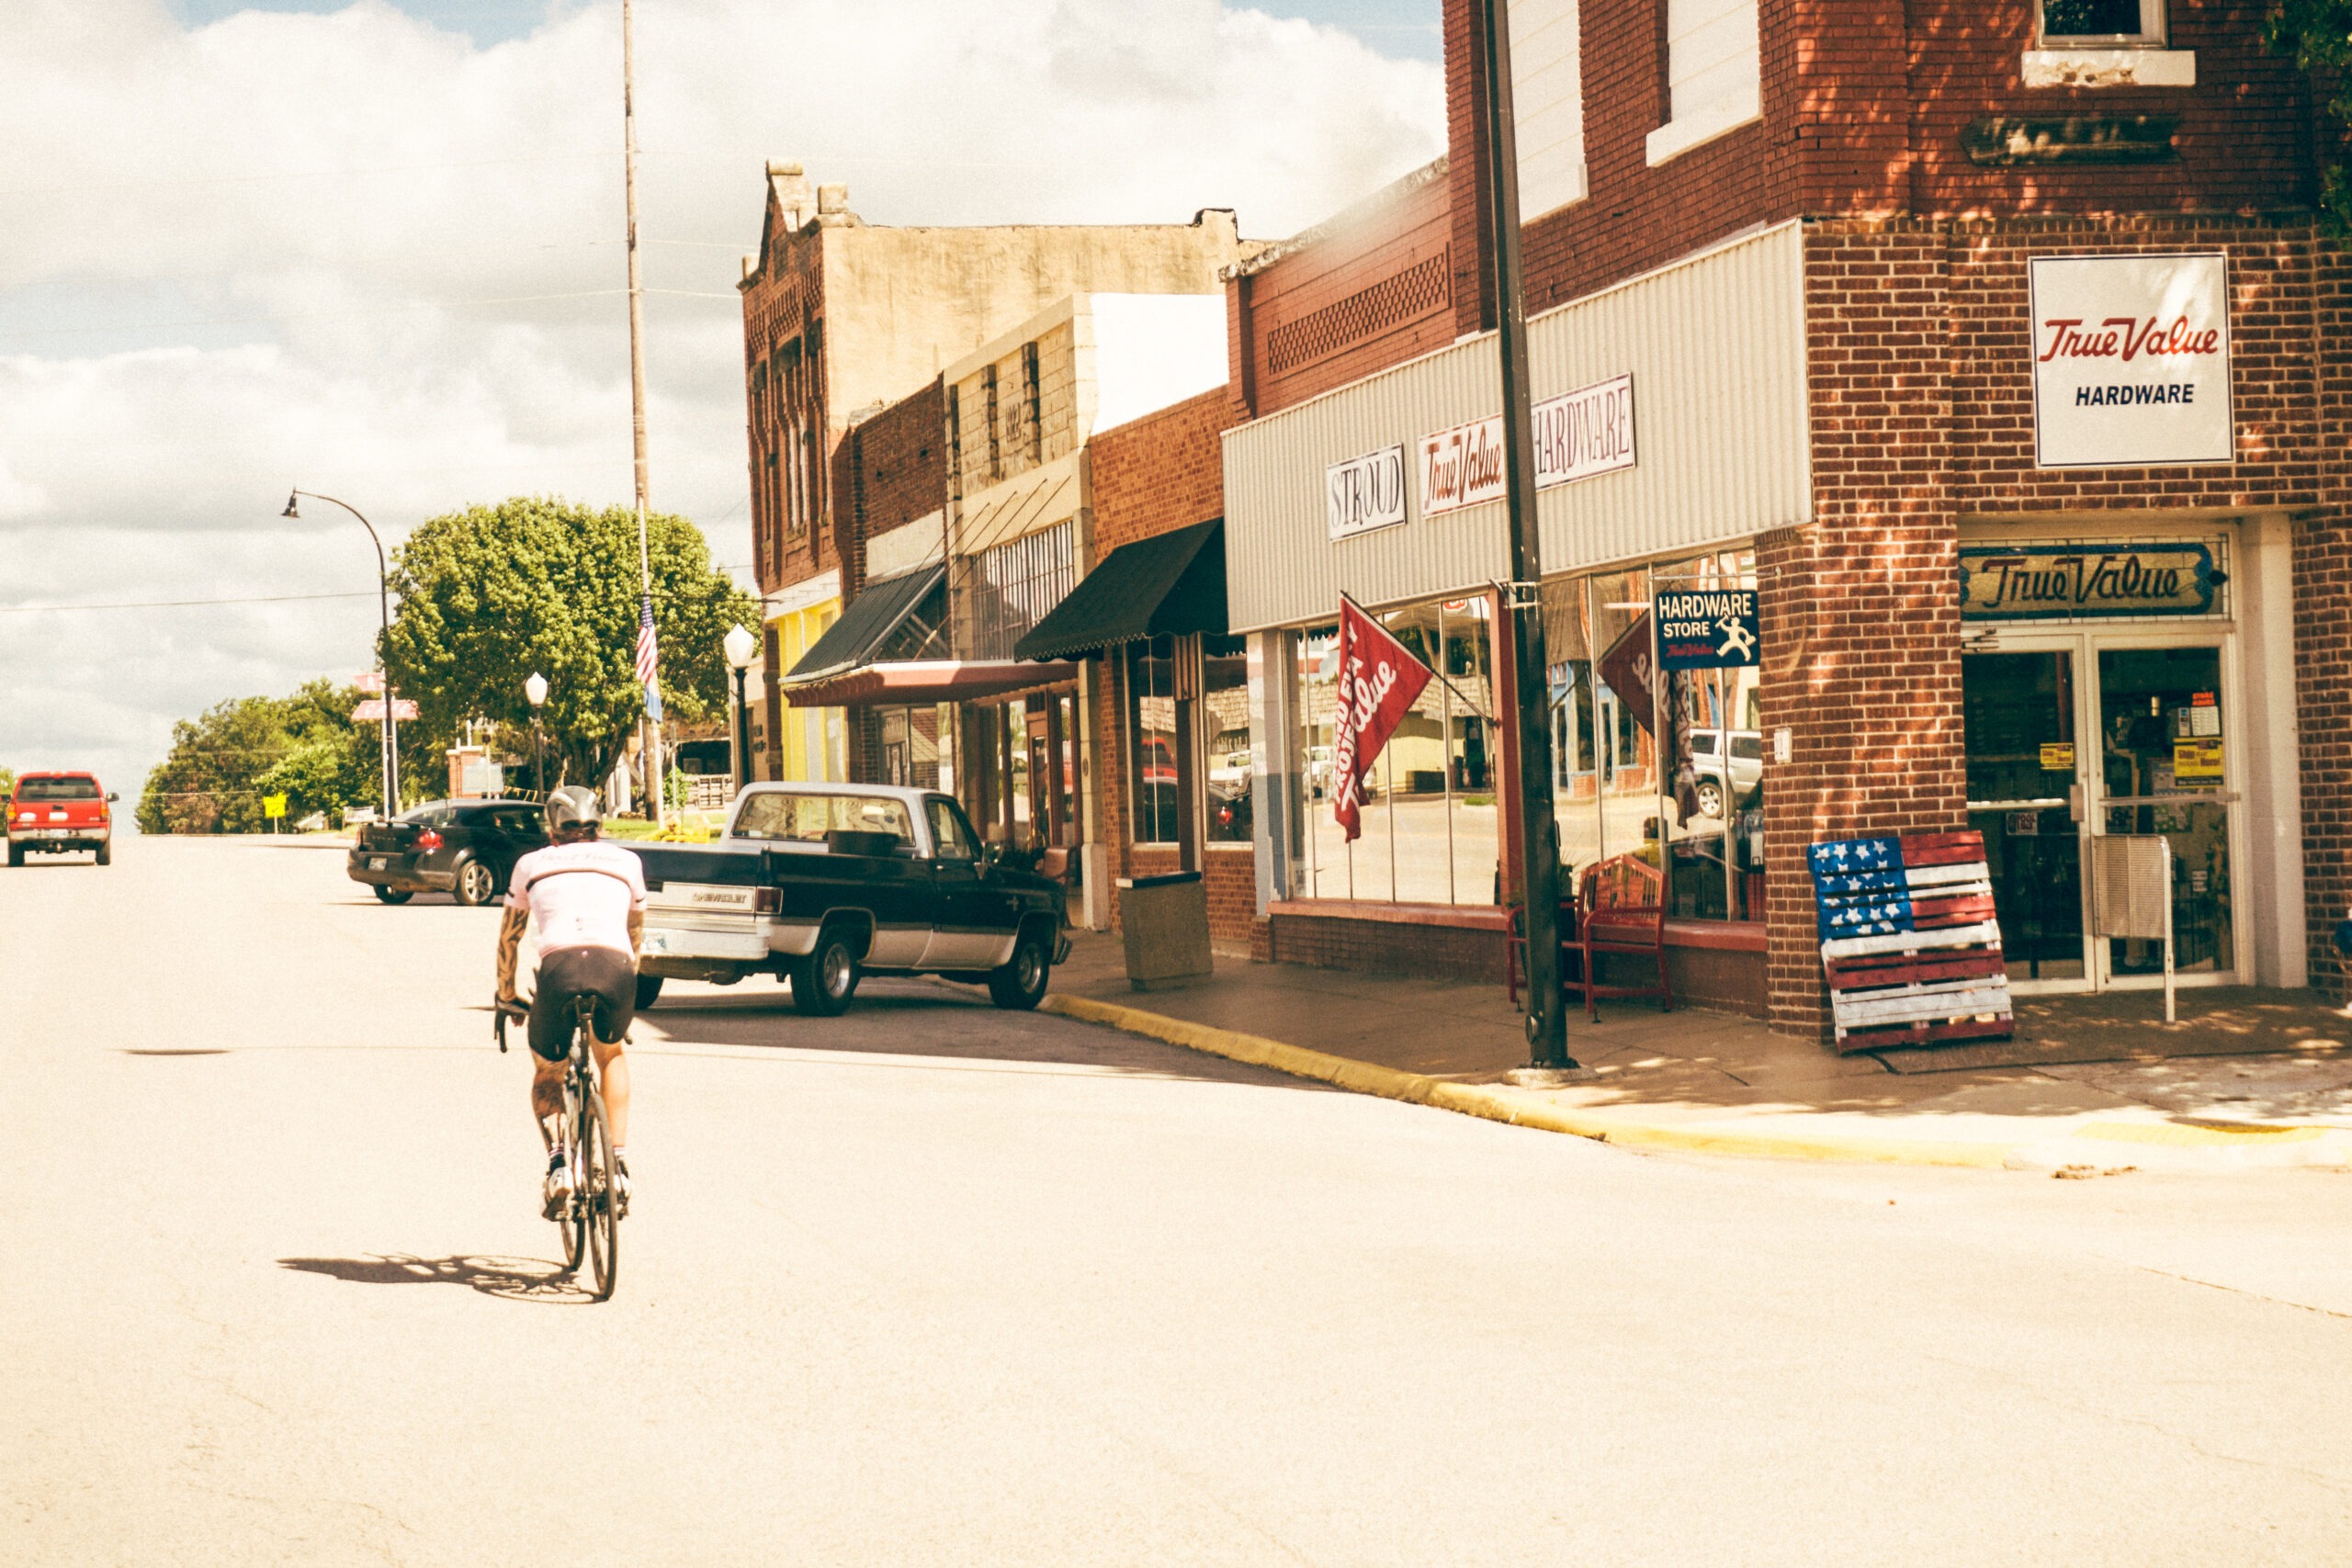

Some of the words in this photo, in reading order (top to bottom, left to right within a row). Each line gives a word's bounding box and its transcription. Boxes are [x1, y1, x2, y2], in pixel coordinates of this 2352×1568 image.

[2075, 383, 2195, 407] HARDWARE
[1531, 386, 1630, 479] HARDWARE
[1331, 454, 1400, 529] STROUD
[1658, 592, 1753, 620] HARDWARE
[1663, 620, 1712, 638] STORE
[1352, 660, 1397, 734] alue
